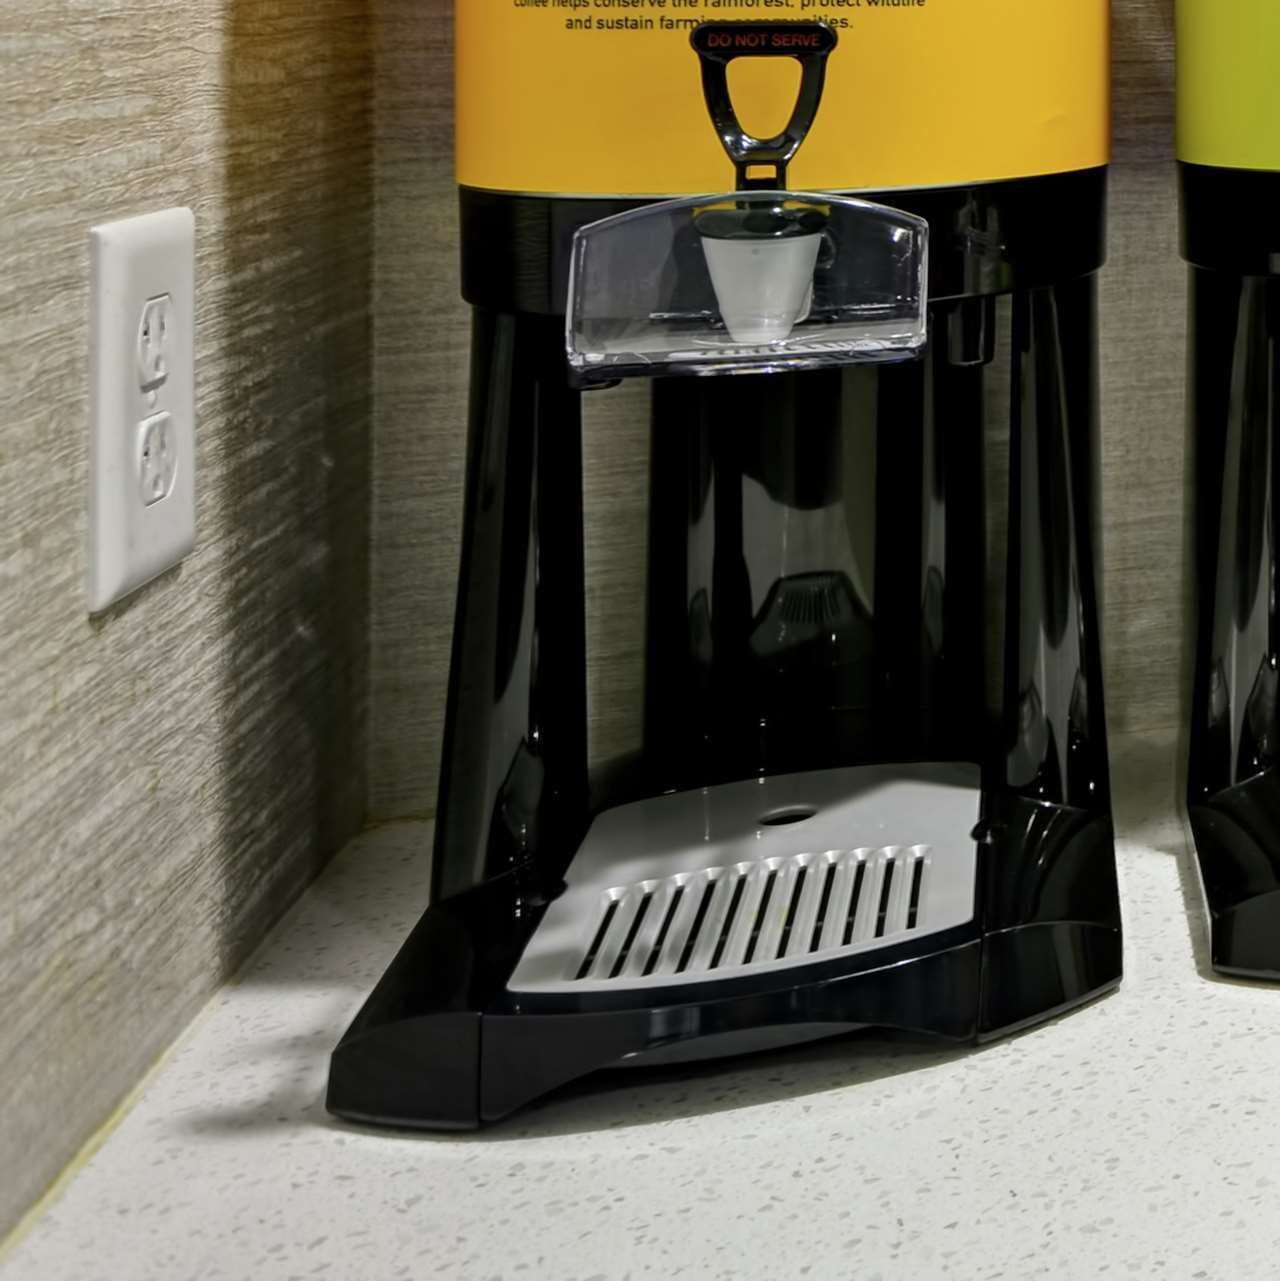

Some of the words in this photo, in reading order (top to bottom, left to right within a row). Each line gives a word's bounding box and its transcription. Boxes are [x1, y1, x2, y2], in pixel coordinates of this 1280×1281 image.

[566, 16, 592, 29] and
[596, 16, 653, 29] sustain
[708, 34, 731, 47] DO
[736, 33, 768, 47] NOT
[771, 33, 821, 46] SERVE
